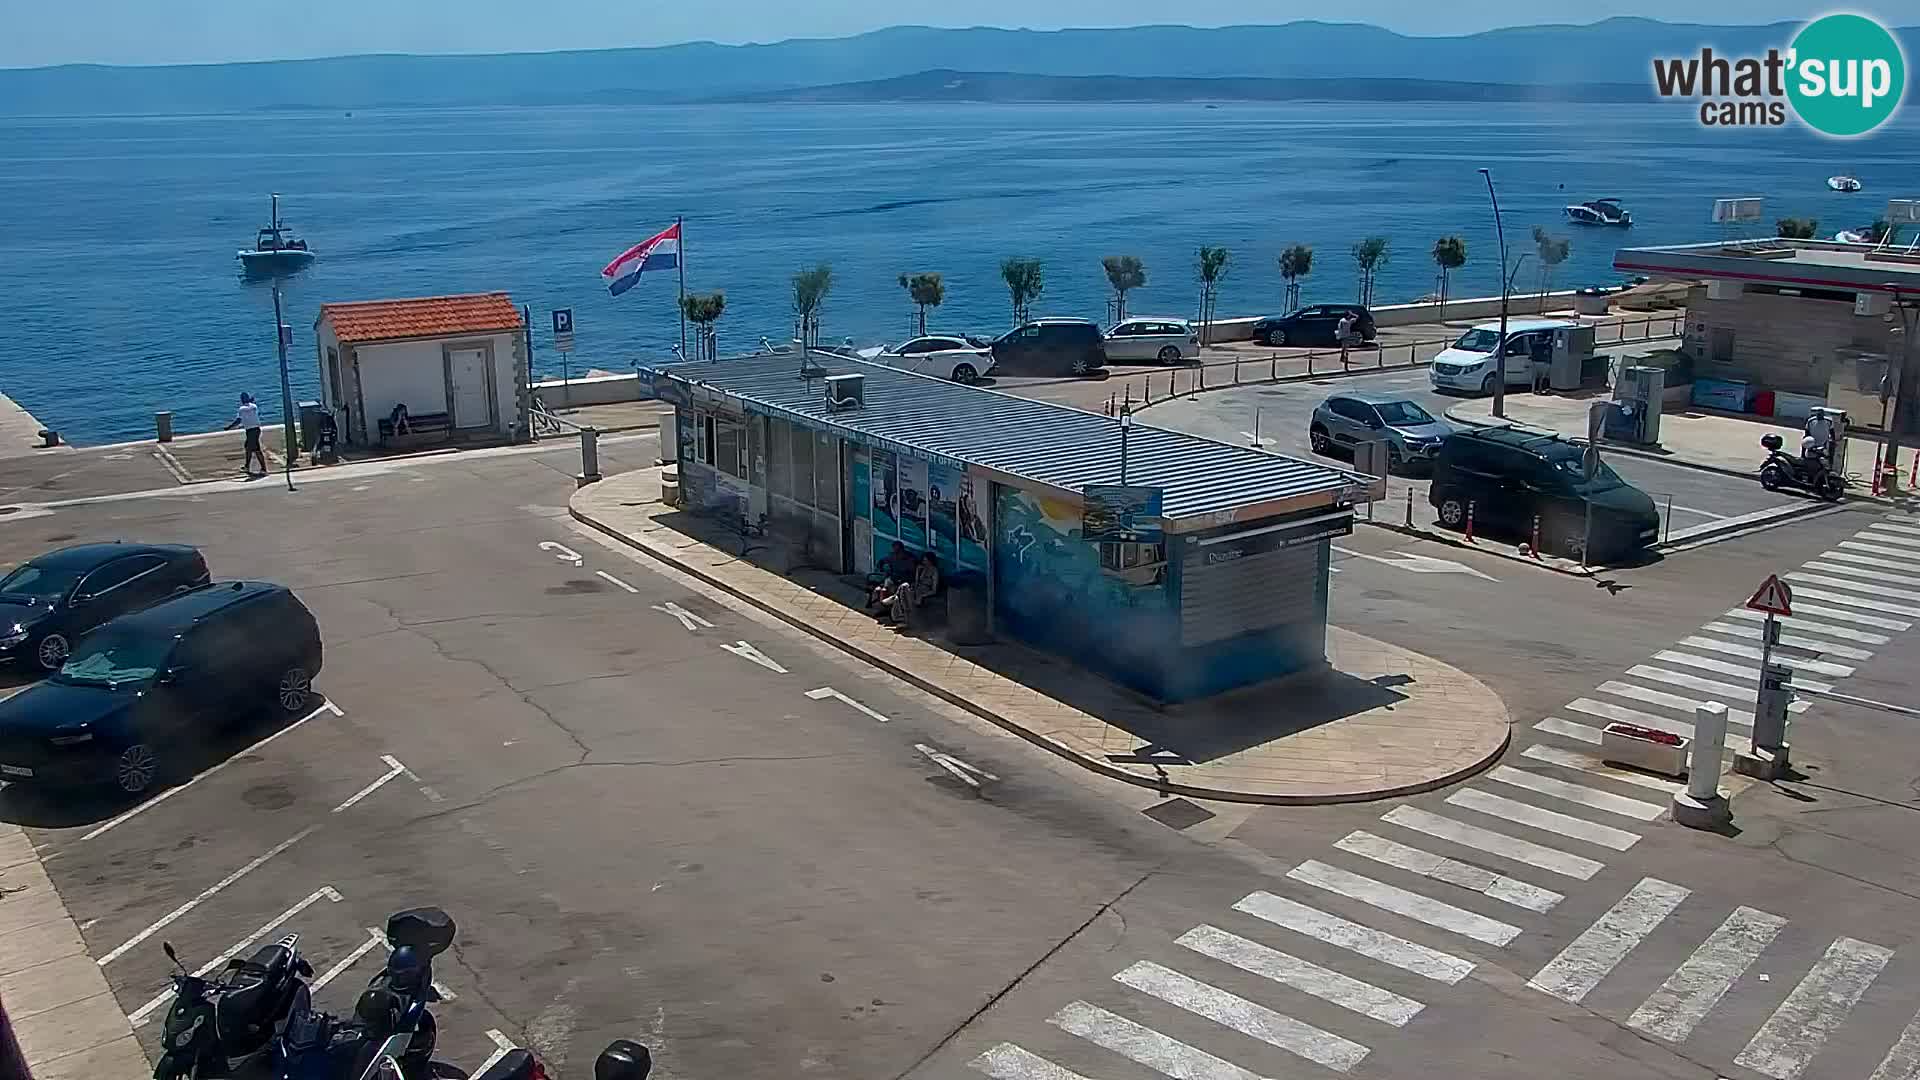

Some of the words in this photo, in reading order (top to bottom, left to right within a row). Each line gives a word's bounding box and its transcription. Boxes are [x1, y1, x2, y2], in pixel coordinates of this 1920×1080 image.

[557, 312, 568, 329] P
[913, 448, 937, 463] TICKET
[938, 456, 964, 471] OFFICE
